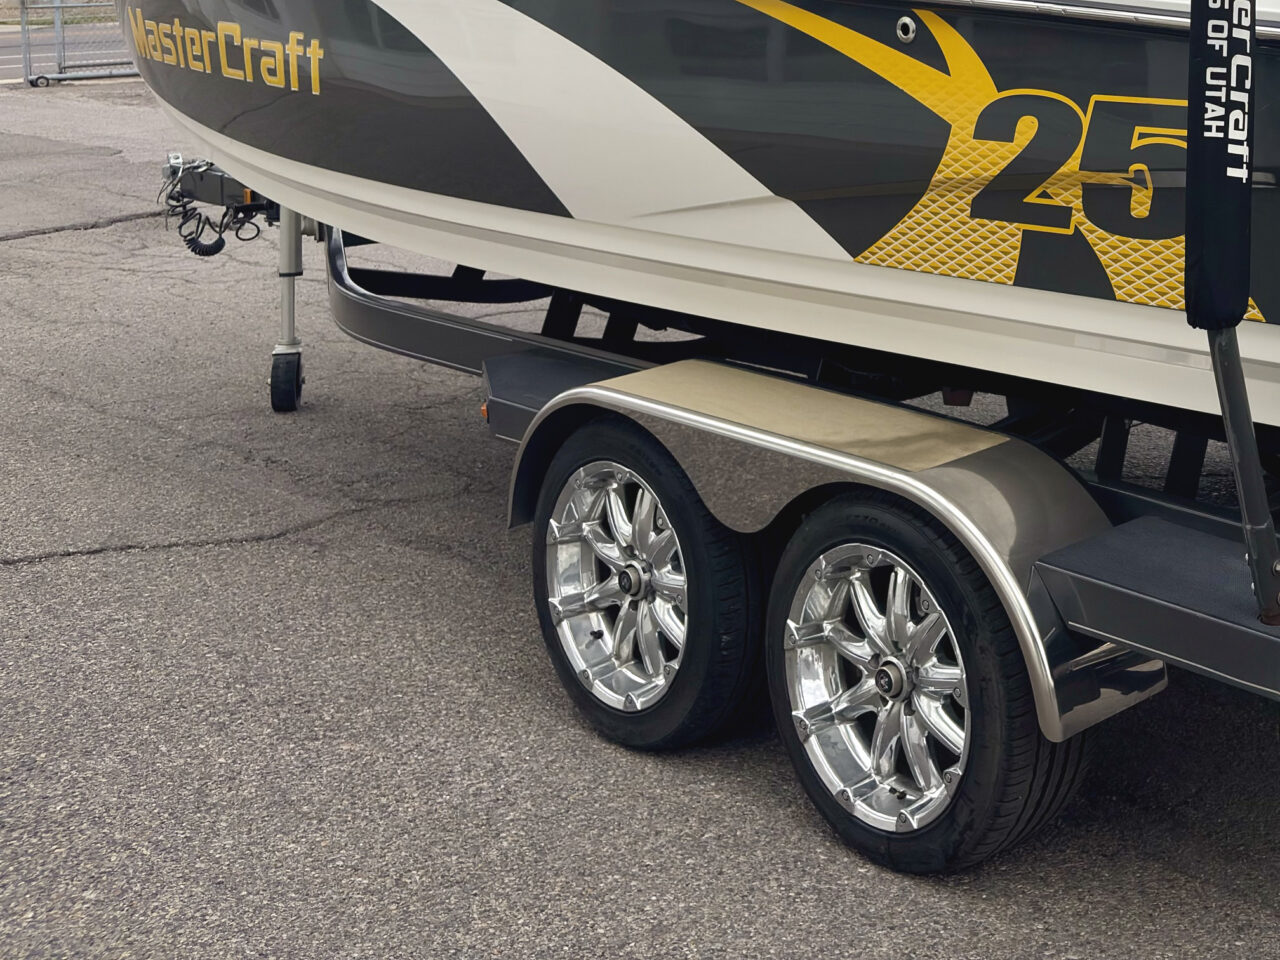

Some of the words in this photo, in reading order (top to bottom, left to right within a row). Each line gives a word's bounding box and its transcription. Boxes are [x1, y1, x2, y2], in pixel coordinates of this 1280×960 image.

[127, 5, 325, 96] MasterCraft
[1206, 20, 1228, 57] OF
[1203, 67, 1227, 138] UTAH
